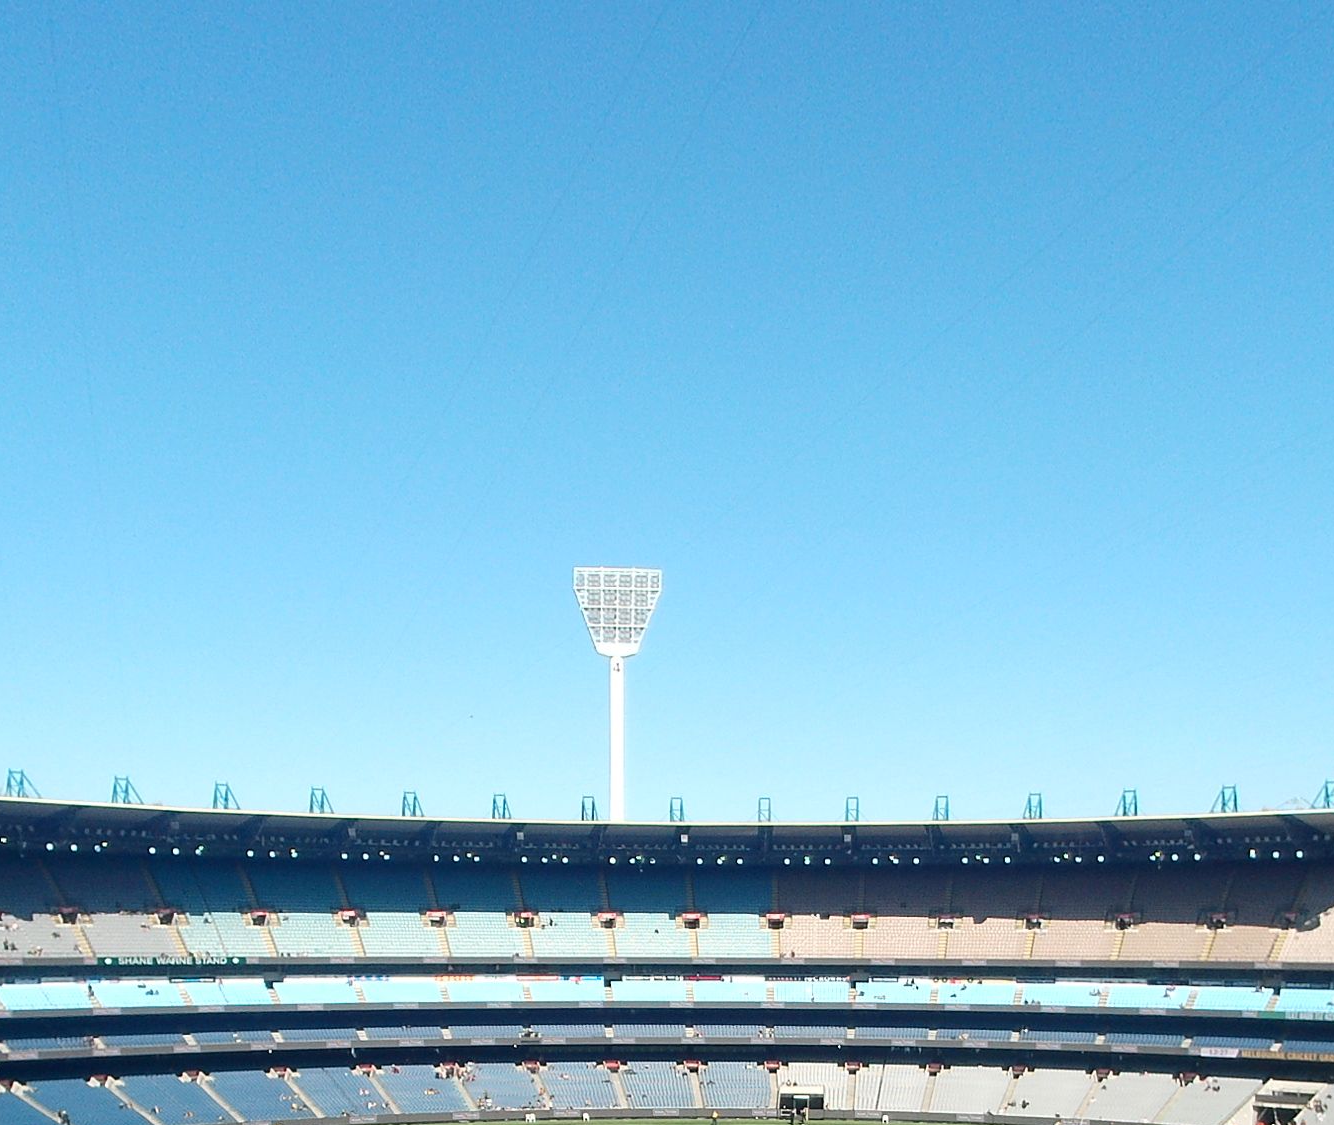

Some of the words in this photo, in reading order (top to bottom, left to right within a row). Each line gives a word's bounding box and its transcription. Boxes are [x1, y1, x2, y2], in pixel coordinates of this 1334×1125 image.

[119, 956, 153, 965] SHANE
[157, 956, 193, 965] WARNE
[196, 956, 227, 965] STAND
